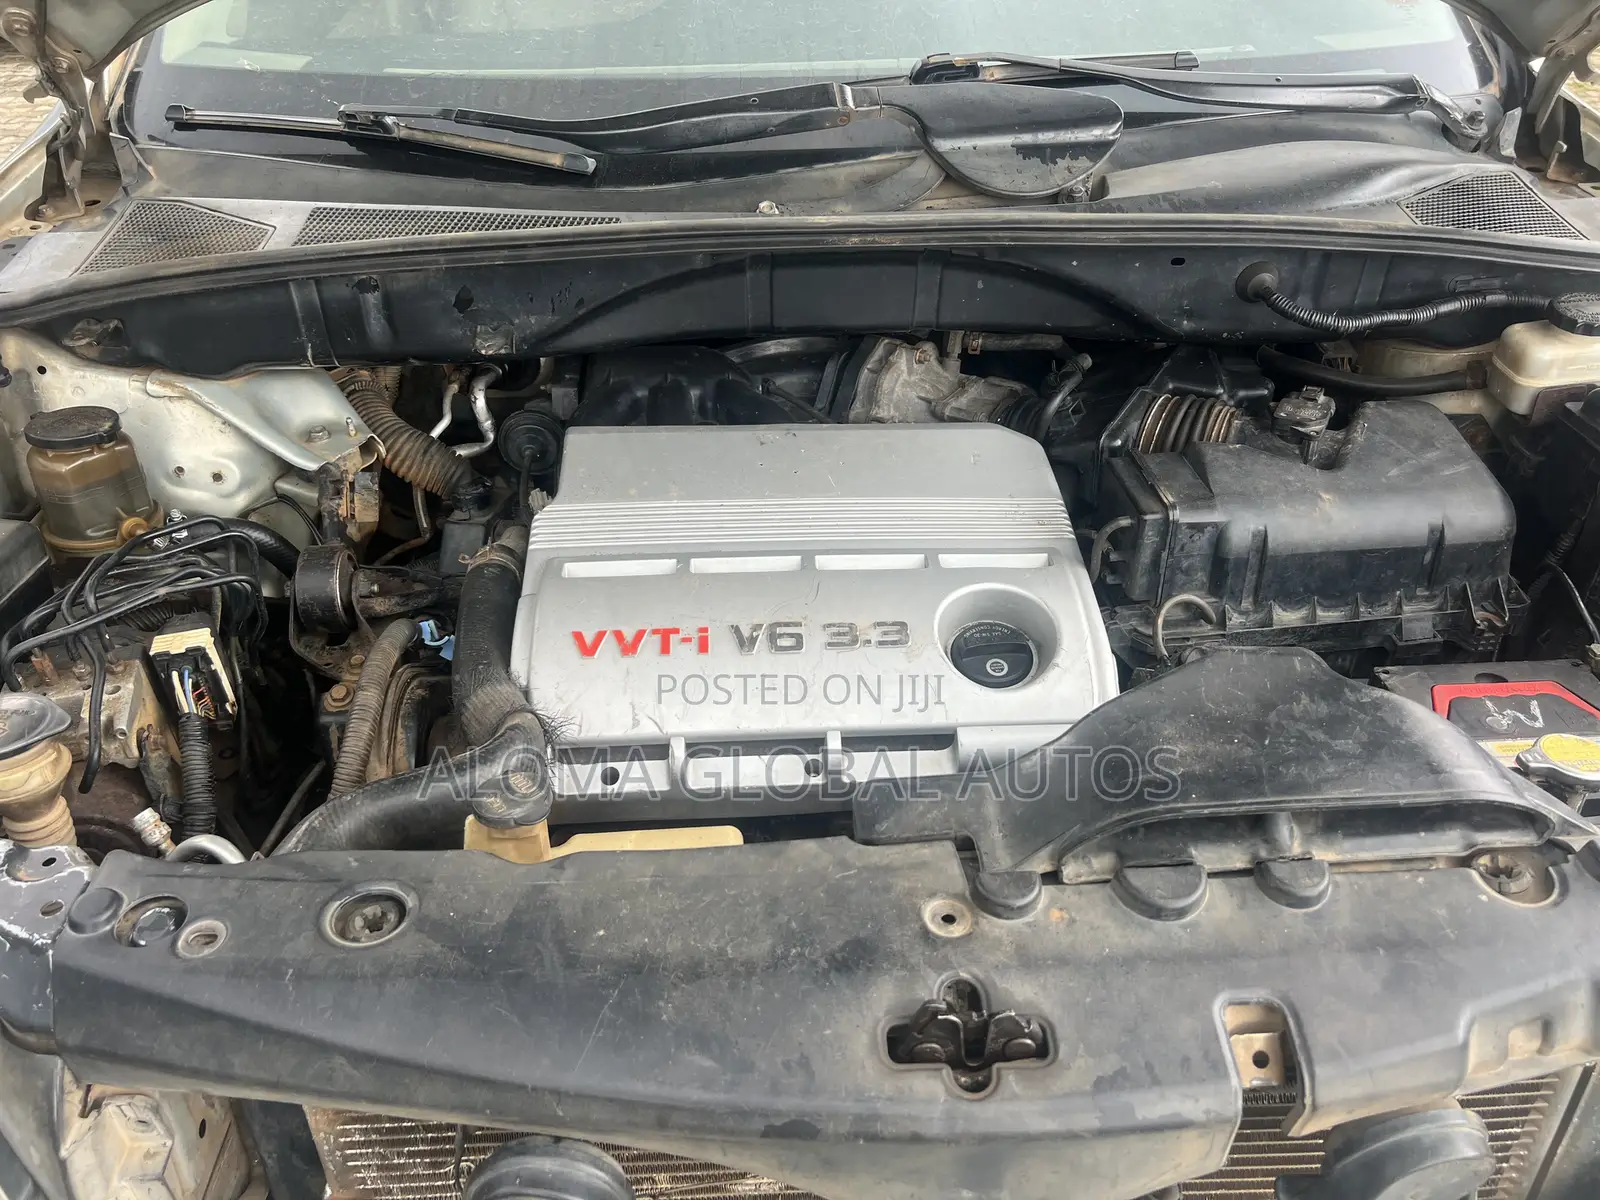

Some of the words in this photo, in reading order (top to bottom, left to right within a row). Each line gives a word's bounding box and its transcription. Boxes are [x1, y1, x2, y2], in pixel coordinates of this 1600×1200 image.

[571, 626, 711, 659] VVT-i
[730, 621, 806, 655] V6
[823, 620, 913, 651] 3.3
